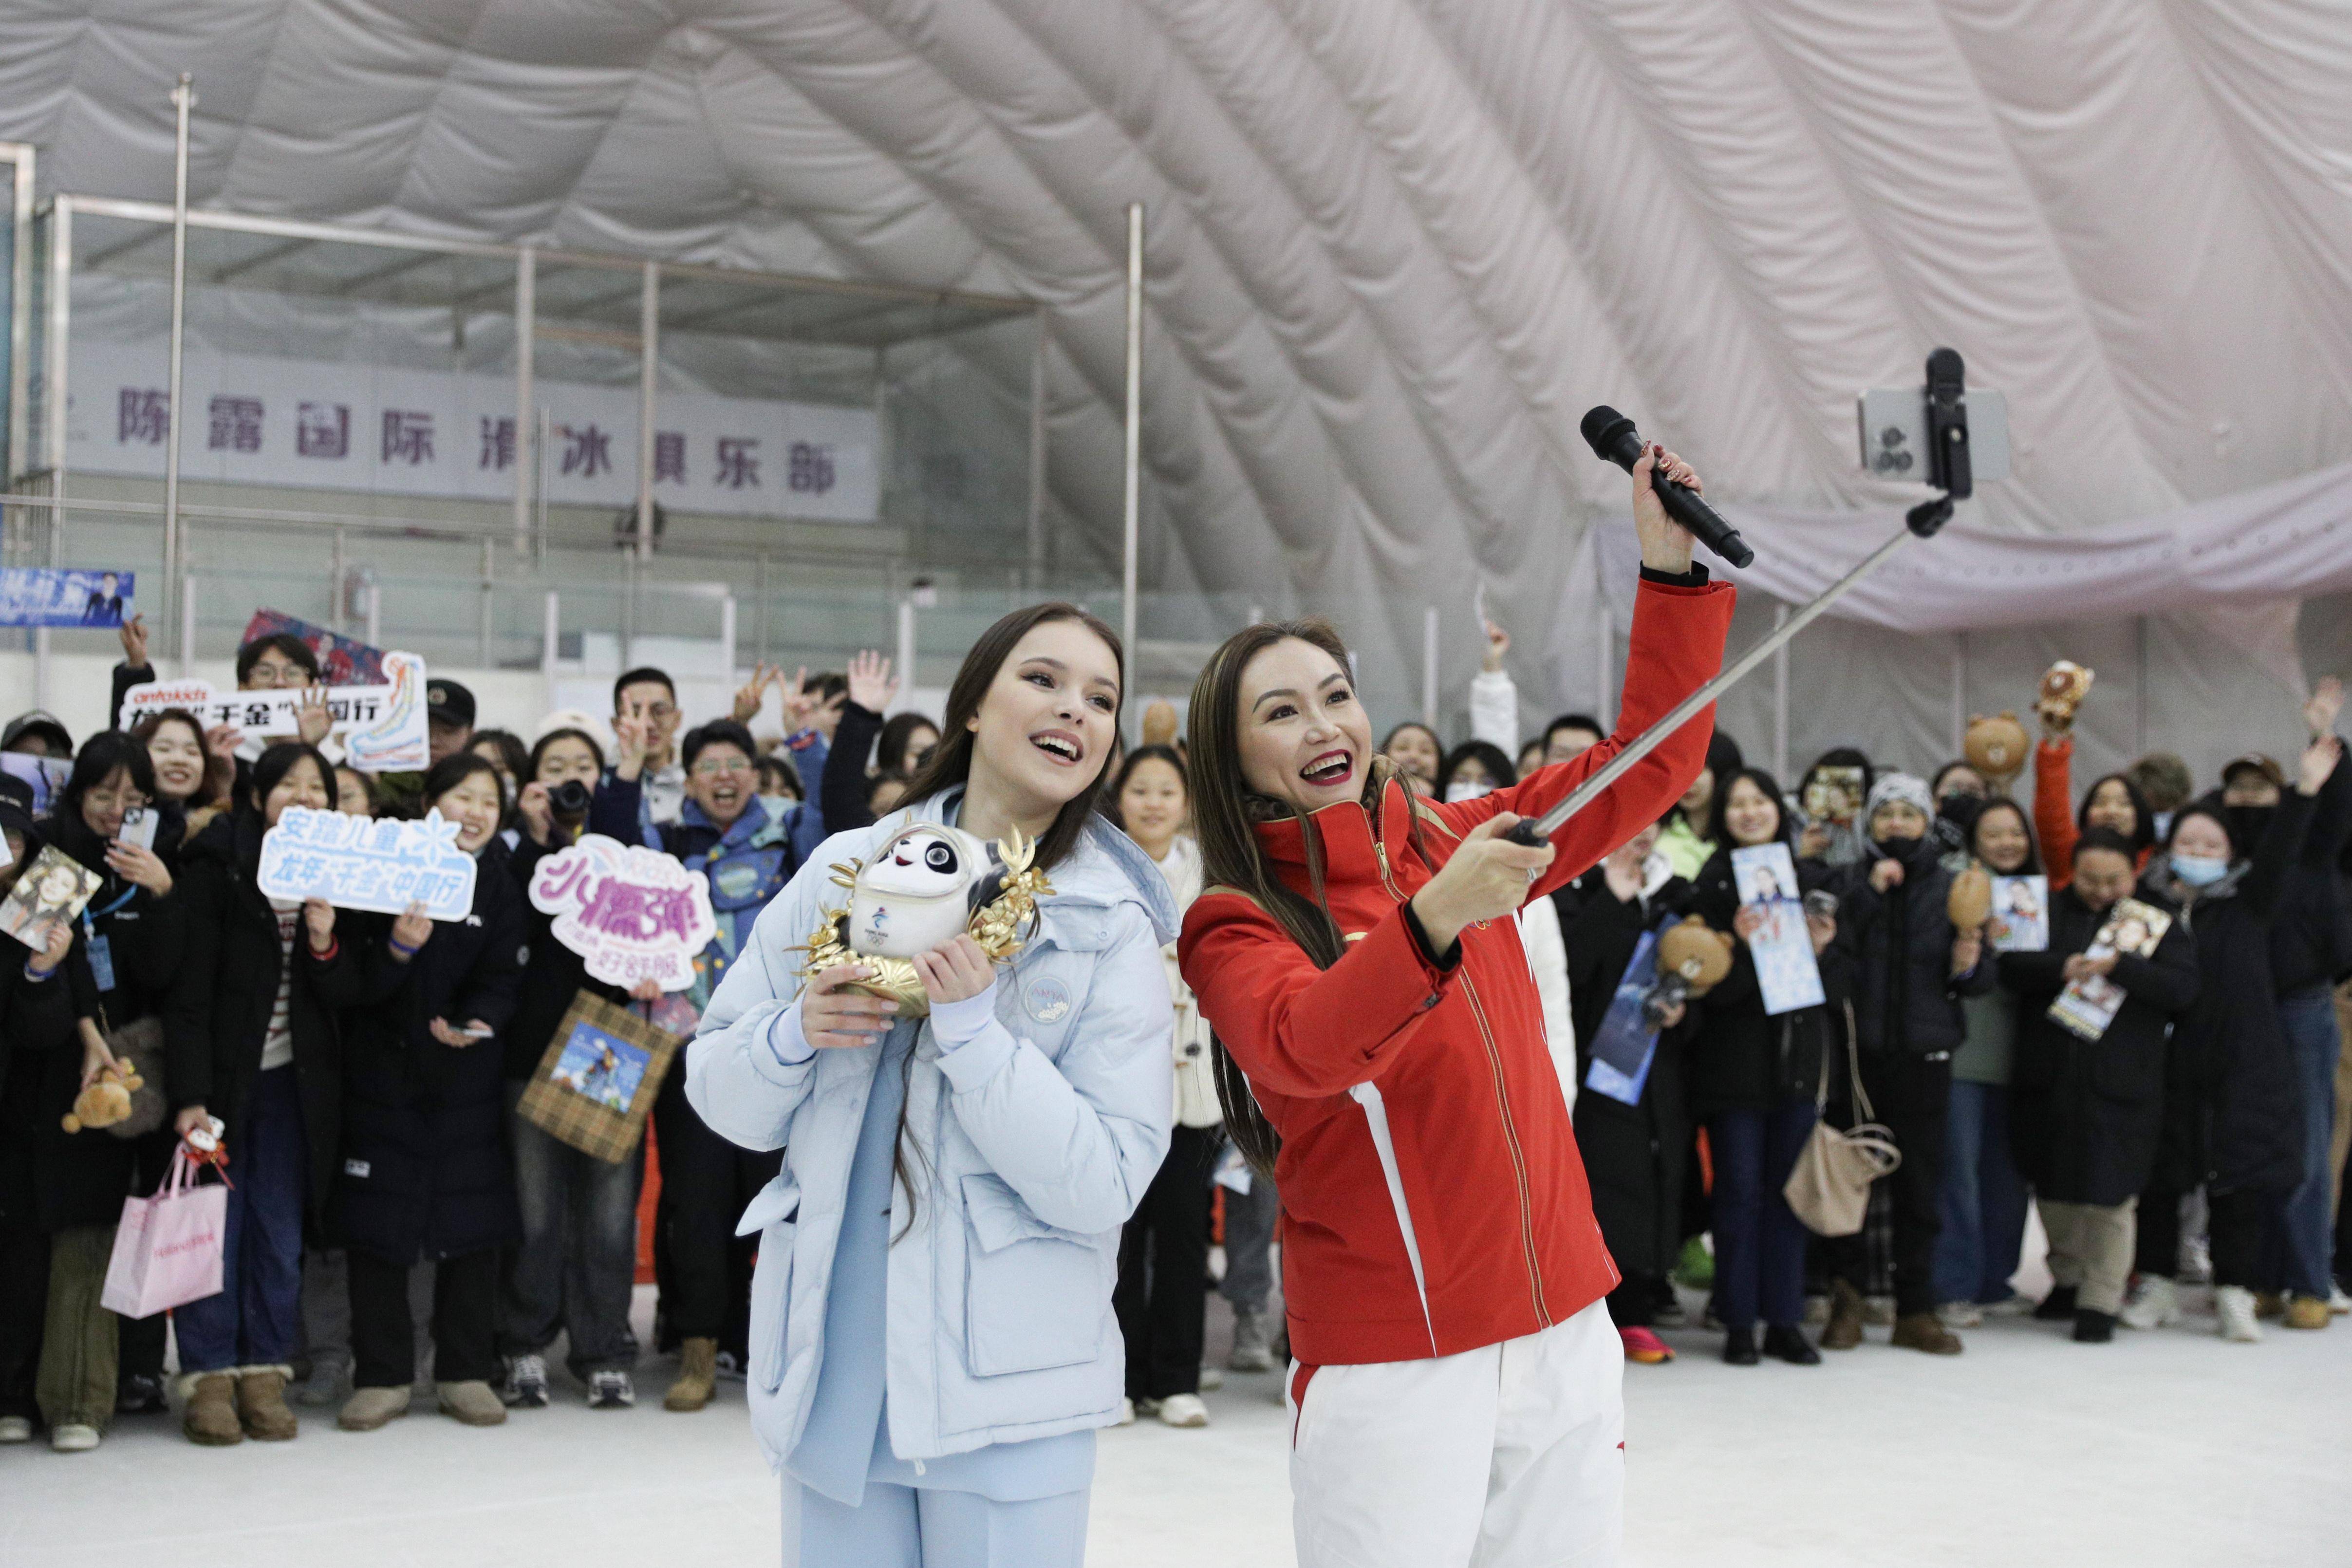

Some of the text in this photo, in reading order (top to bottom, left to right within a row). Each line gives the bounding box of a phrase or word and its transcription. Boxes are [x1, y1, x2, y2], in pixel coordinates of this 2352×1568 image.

[280, 811, 402, 851] 安踏儿童
[598, 951, 681, 978] 好舒服
